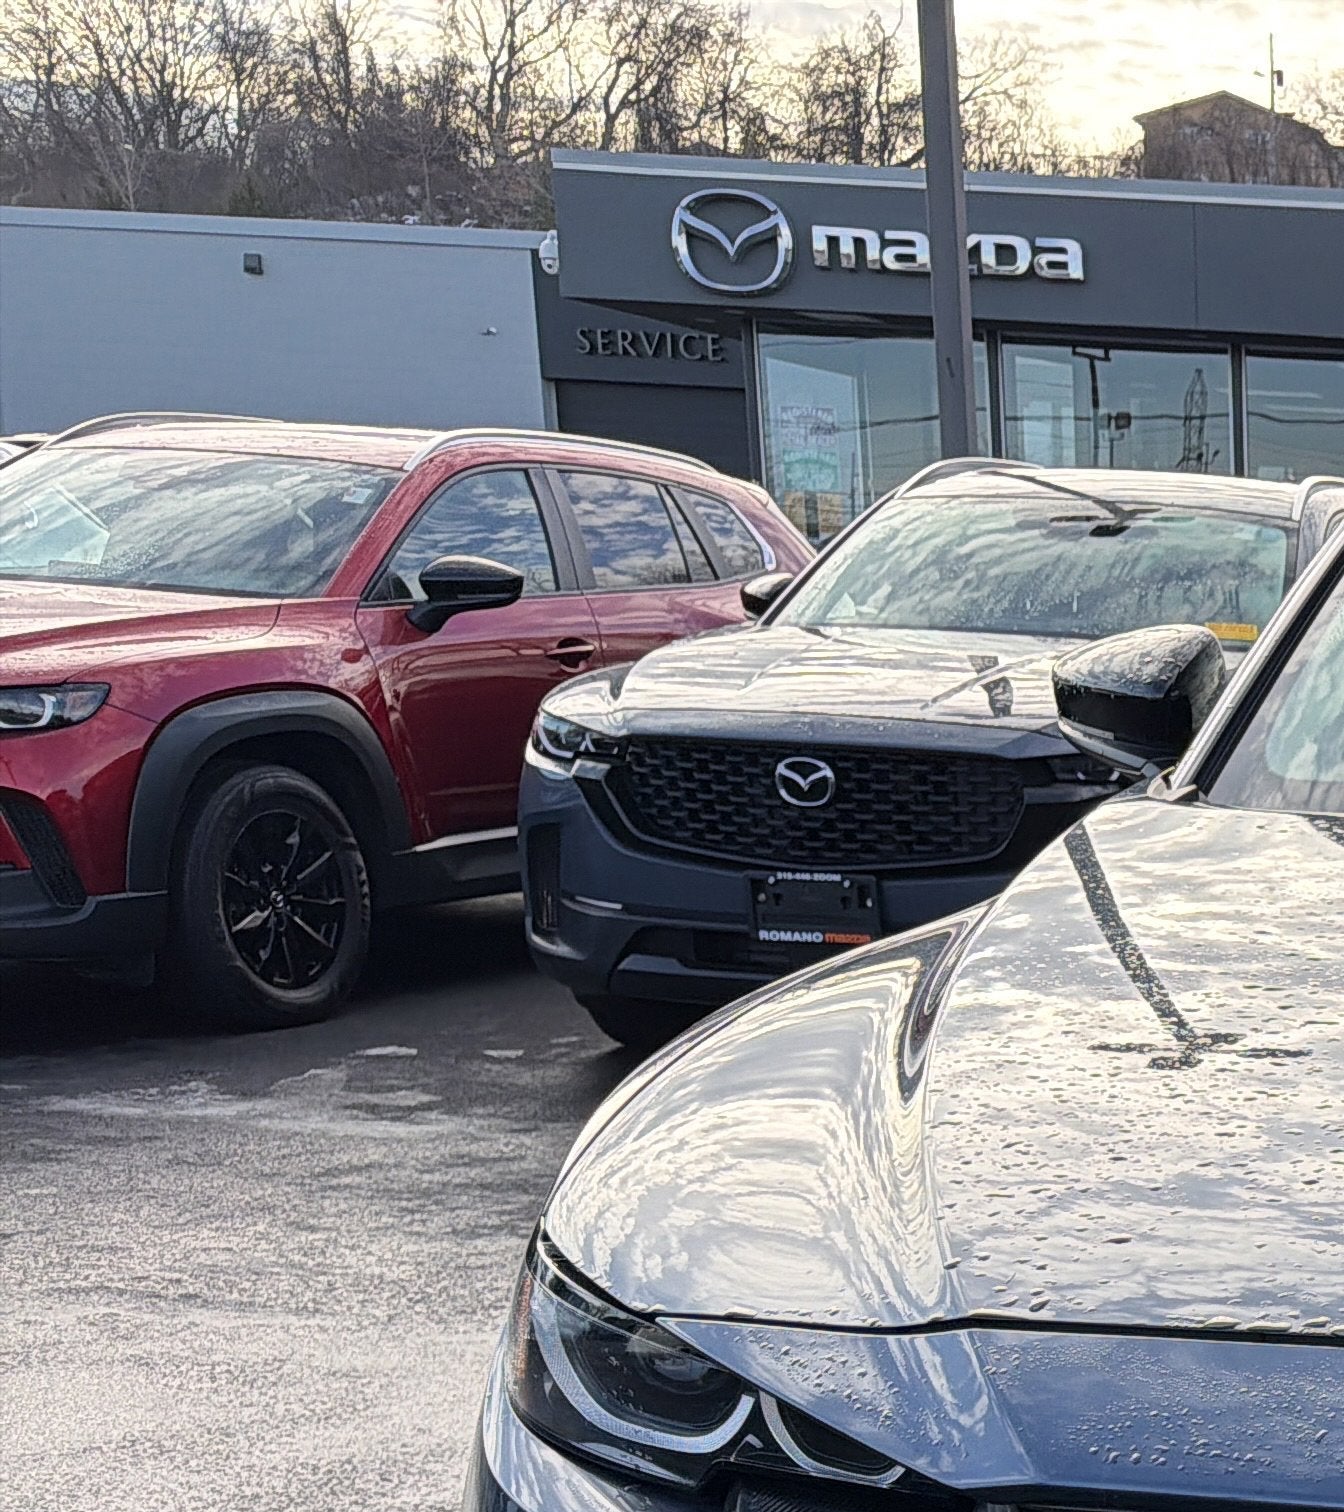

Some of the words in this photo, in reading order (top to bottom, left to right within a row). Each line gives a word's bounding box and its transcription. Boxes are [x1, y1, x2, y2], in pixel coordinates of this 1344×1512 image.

[811, 224, 1085, 281] mada
[576, 327, 722, 361] SERVICE
[758, 929, 824, 943] ROMANO
